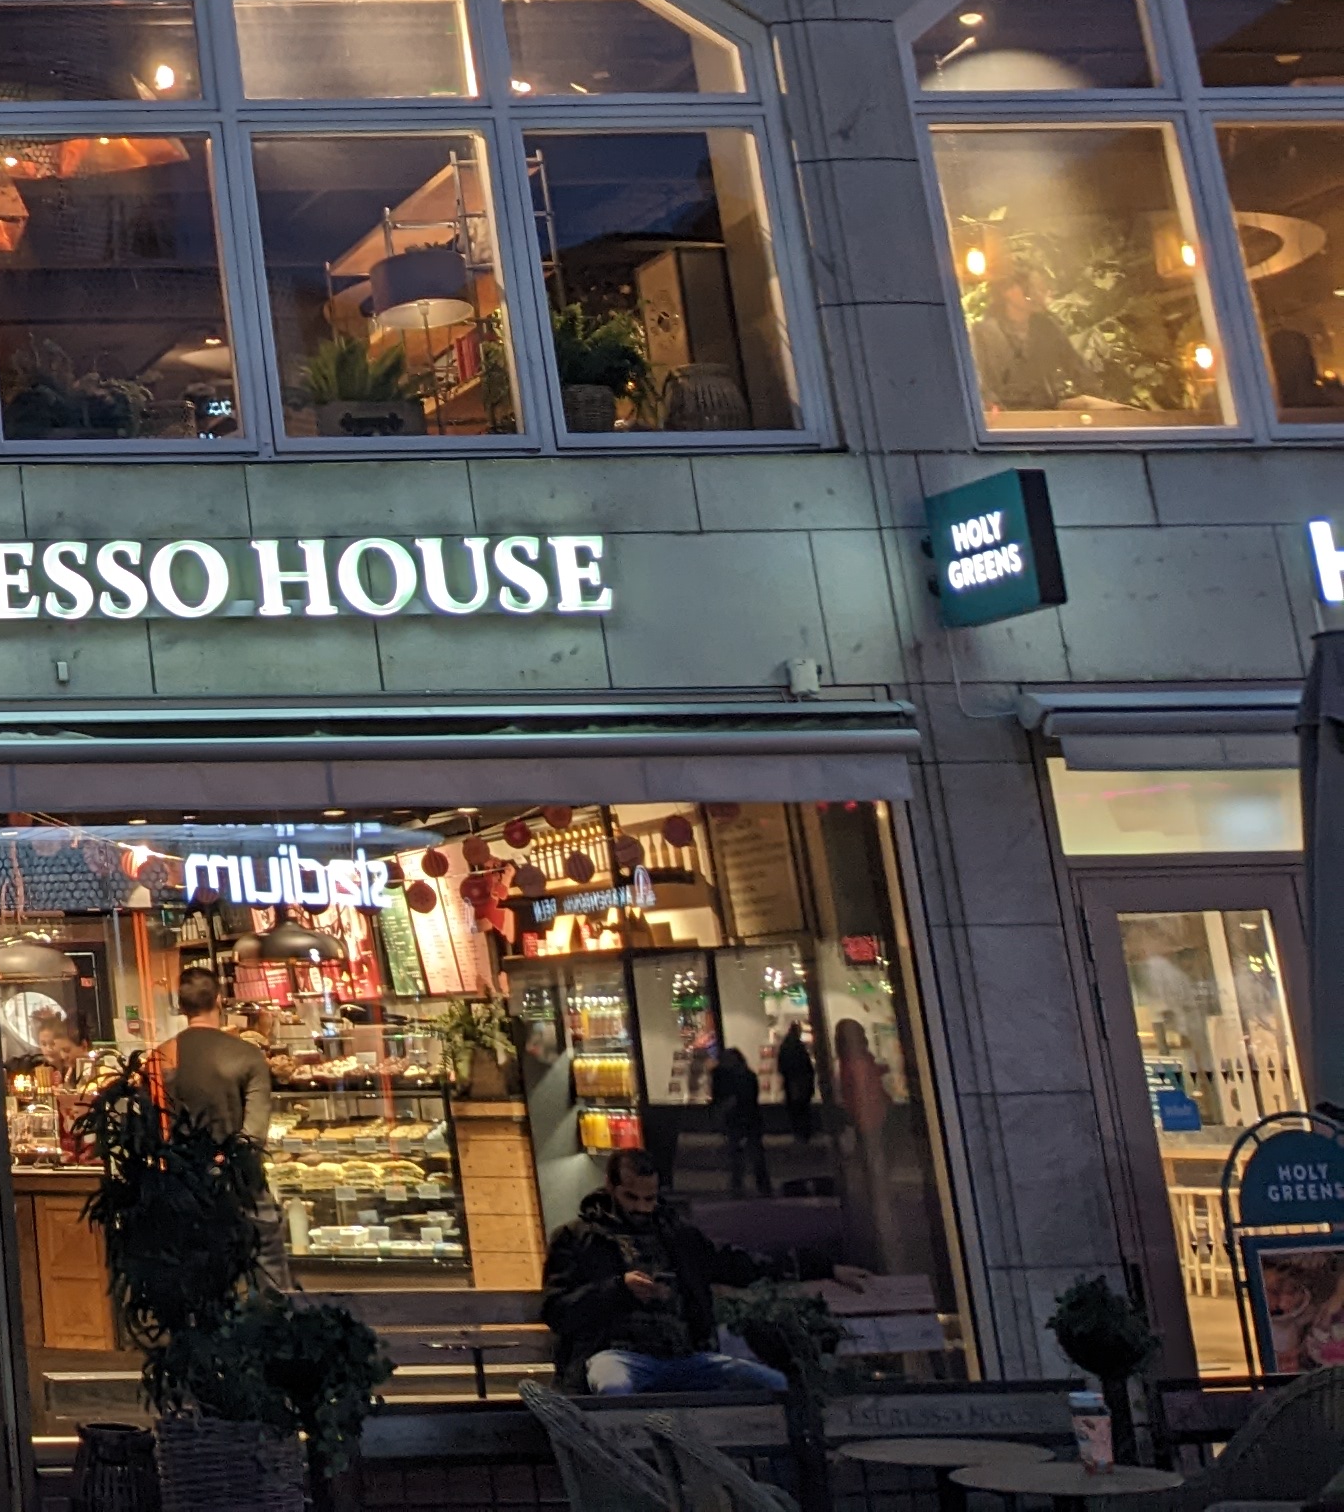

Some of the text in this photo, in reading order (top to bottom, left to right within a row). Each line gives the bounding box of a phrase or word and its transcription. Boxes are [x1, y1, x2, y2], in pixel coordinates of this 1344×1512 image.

[950, 510, 1004, 553] HOLY
[251, 534, 614, 618] HOUSE
[947, 543, 1024, 590] GREENS
[1267, 1182, 1344, 1203] GREENS
[1278, 1163, 1329, 1182] HOLY
